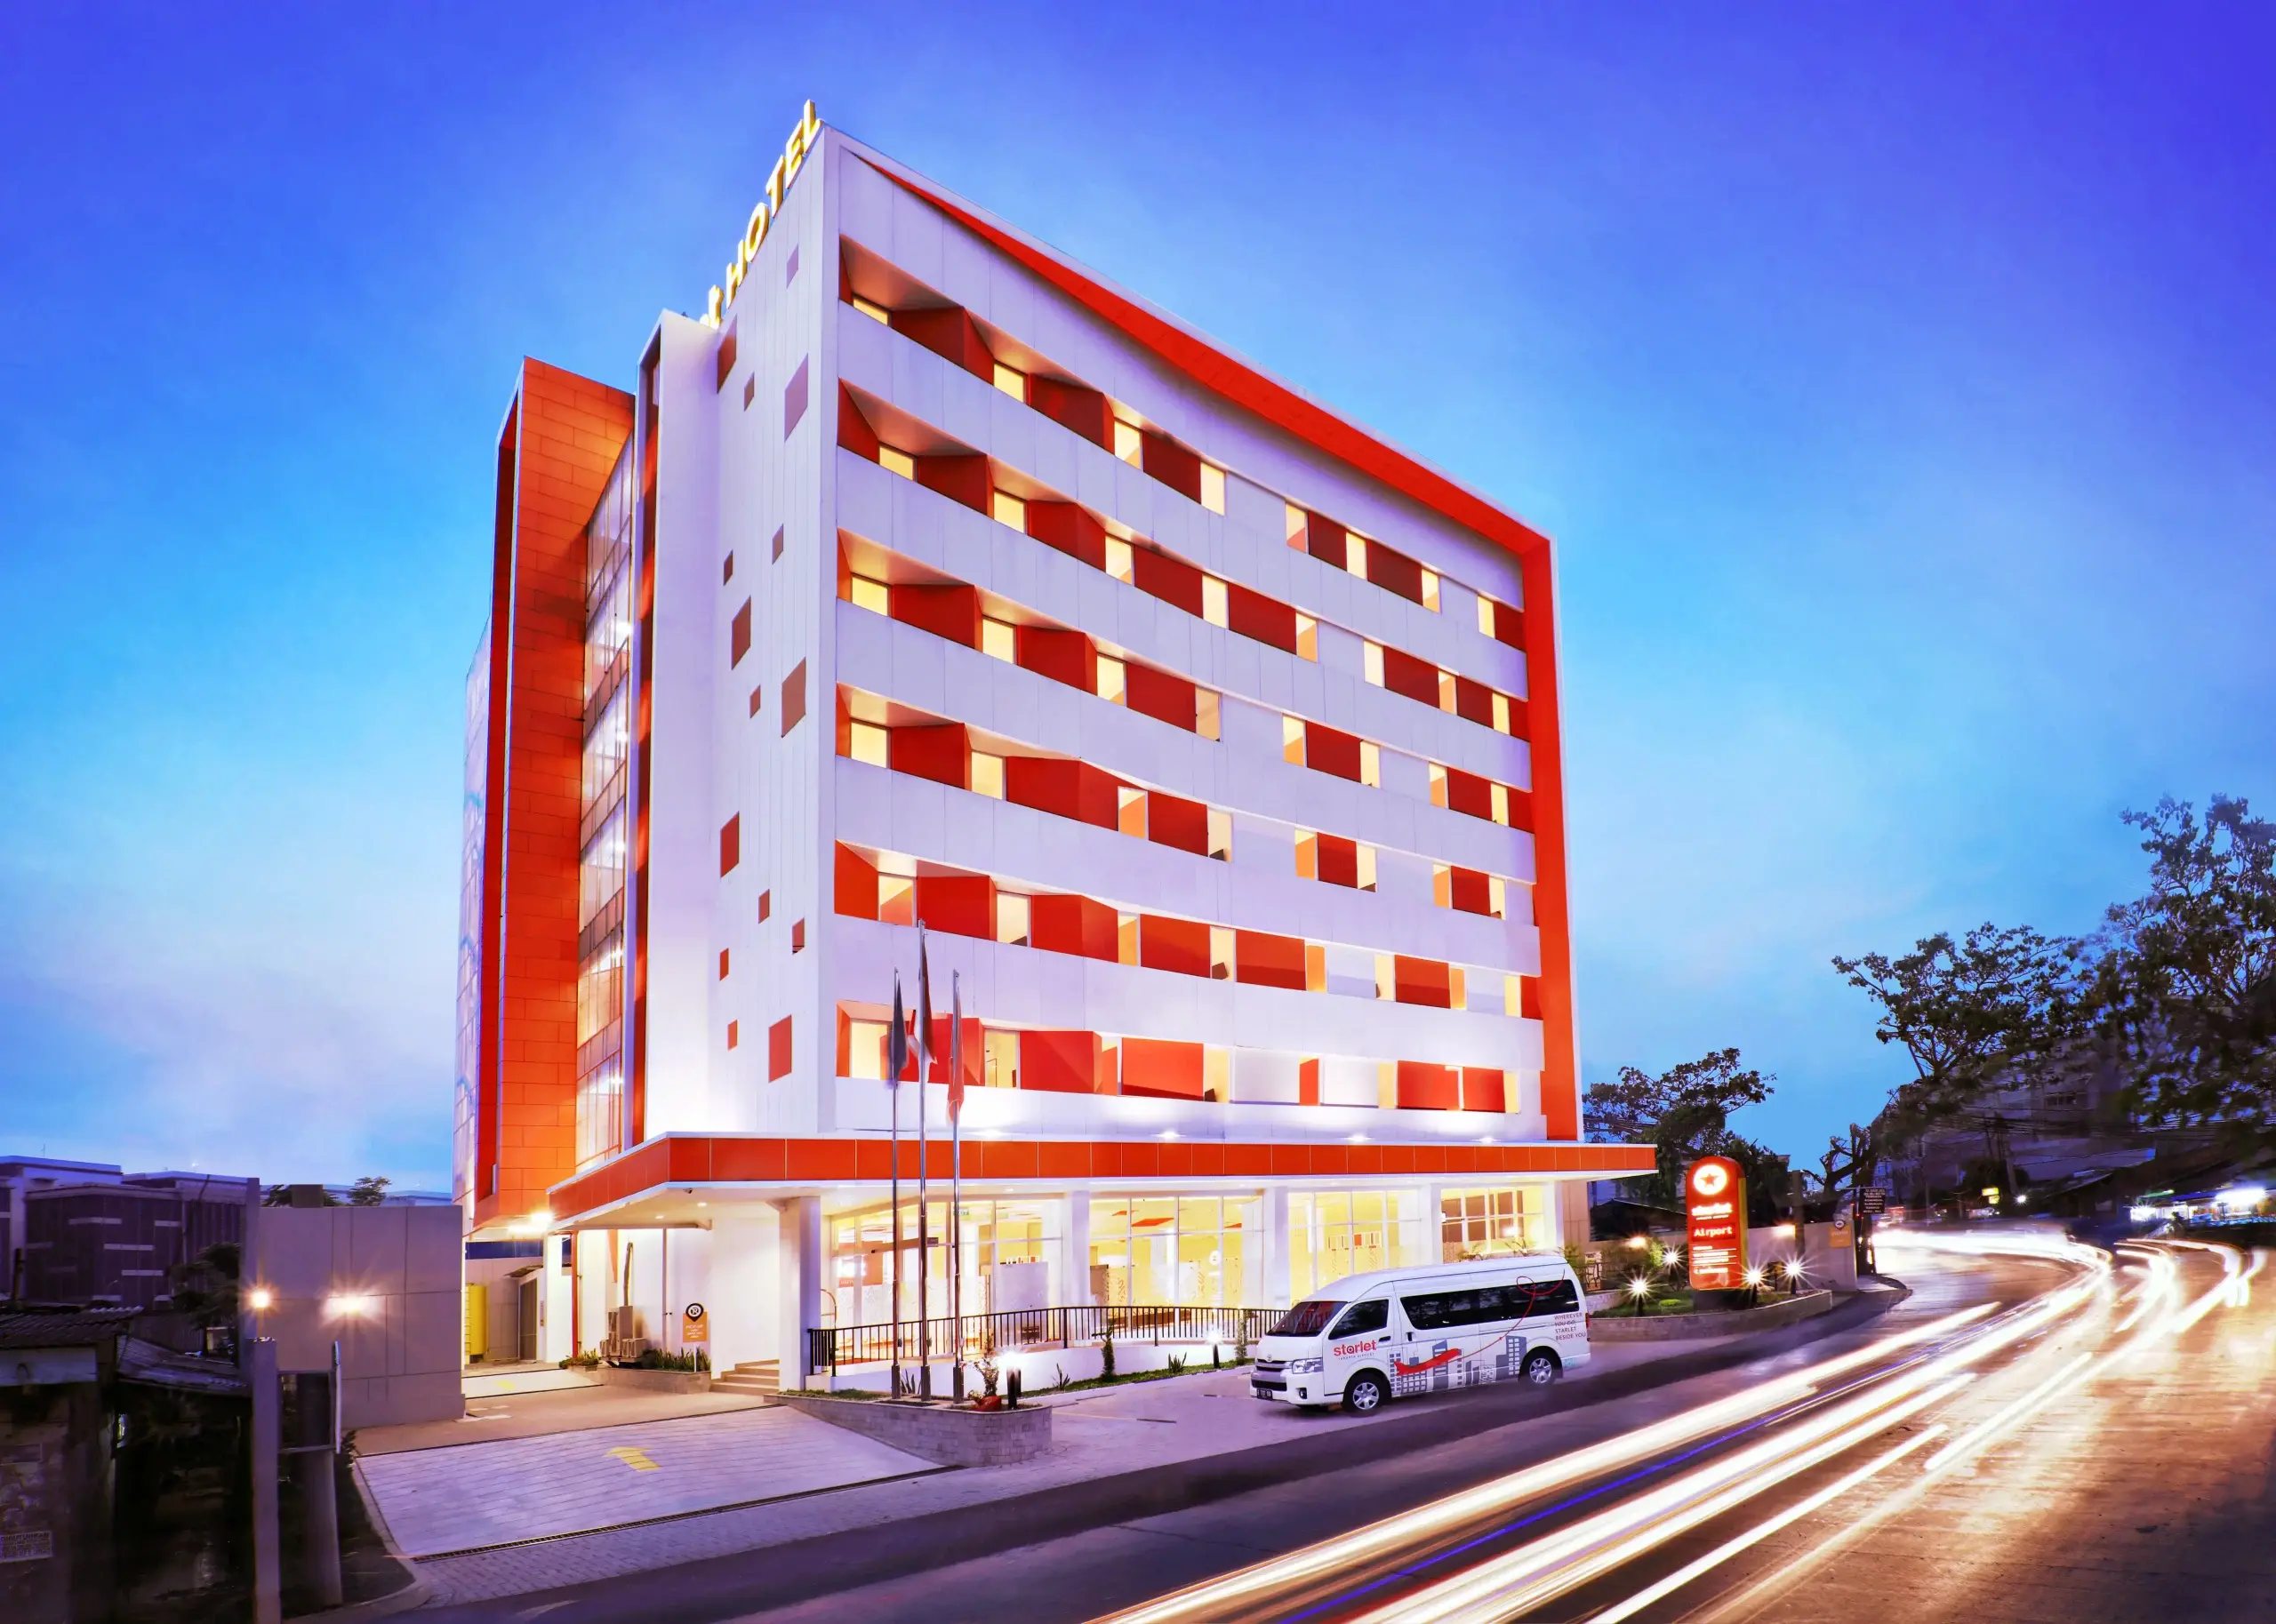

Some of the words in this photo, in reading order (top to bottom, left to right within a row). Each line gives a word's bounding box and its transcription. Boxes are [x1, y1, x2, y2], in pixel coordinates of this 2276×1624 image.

[725, 99, 823, 309] HOTEL
[1694, 1226, 1733, 1237] Airport
[1554, 1312, 1583, 1321] WHEREVER
[1334, 1340, 1377, 1356] starlet
